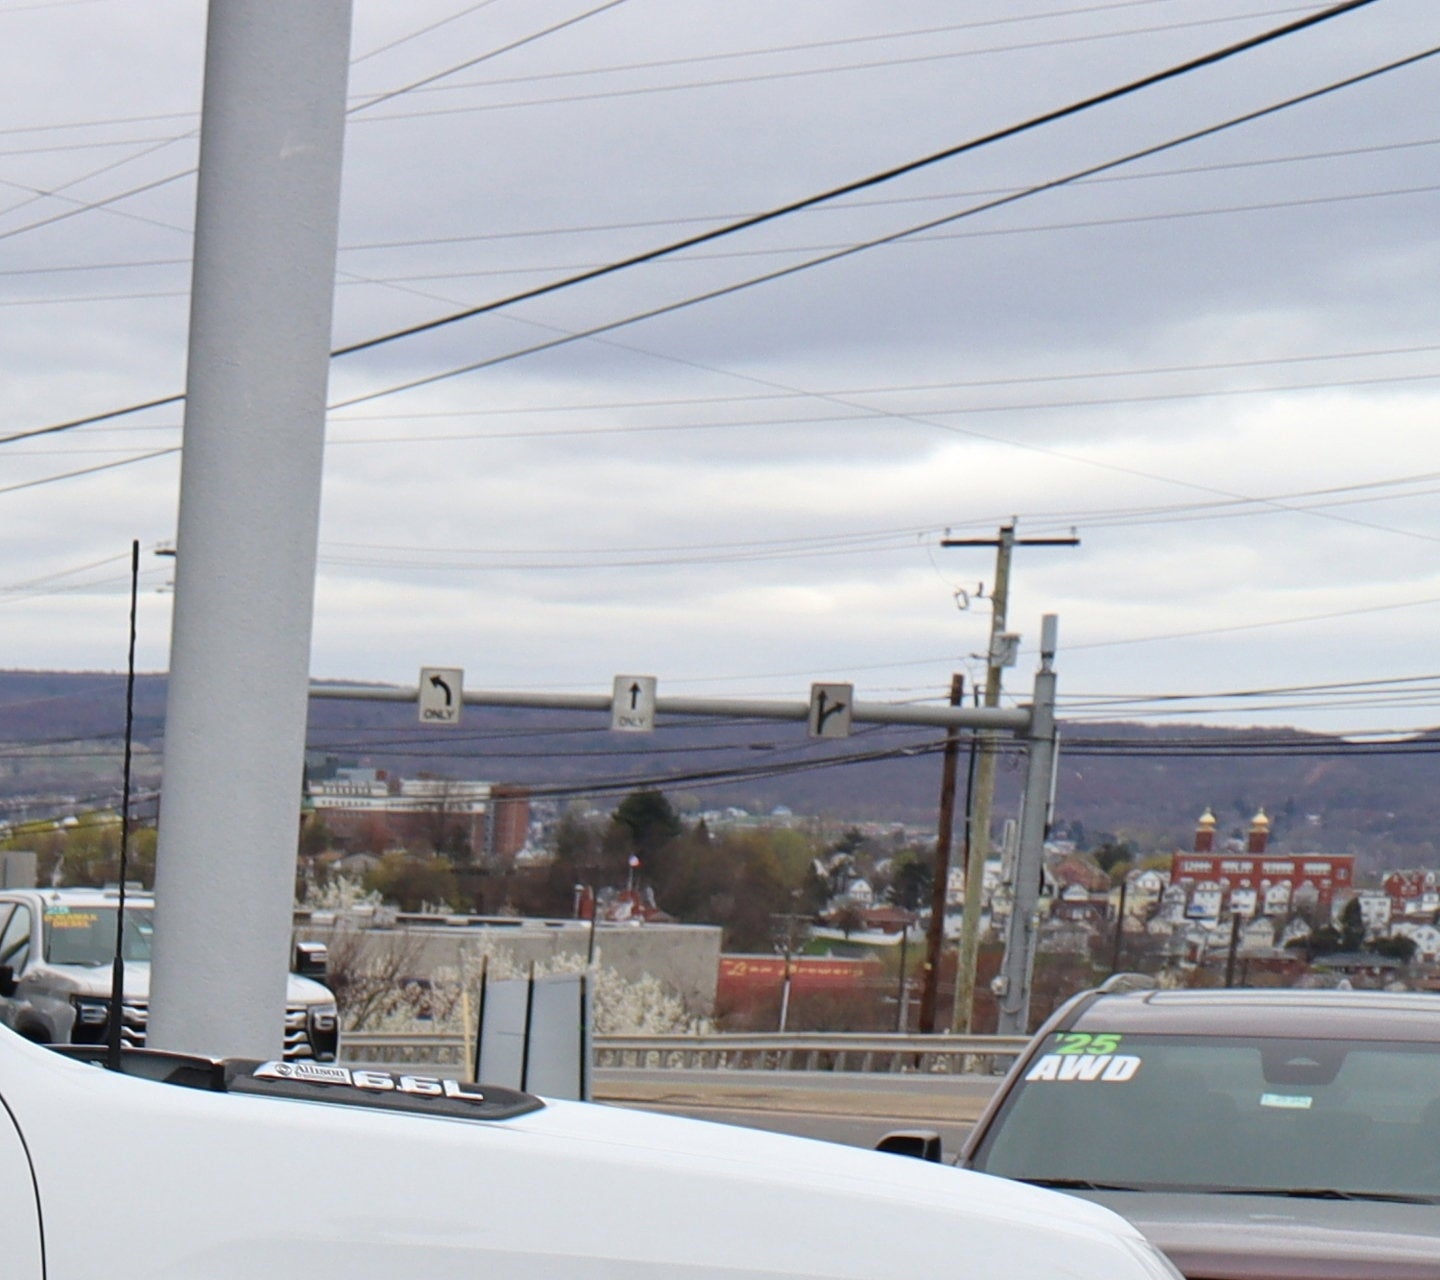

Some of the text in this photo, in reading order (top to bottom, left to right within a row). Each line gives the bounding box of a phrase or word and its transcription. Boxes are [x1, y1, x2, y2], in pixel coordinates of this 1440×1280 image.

[423, 708, 454, 720] ONLY
[619, 715, 649, 727] ONLY
[1054, 1033, 1123, 1055] '25
[295, 1063, 345, 1078] Allison
[1025, 1054, 1141, 1081] AWD
[352, 1069, 484, 1100] 6.6L
